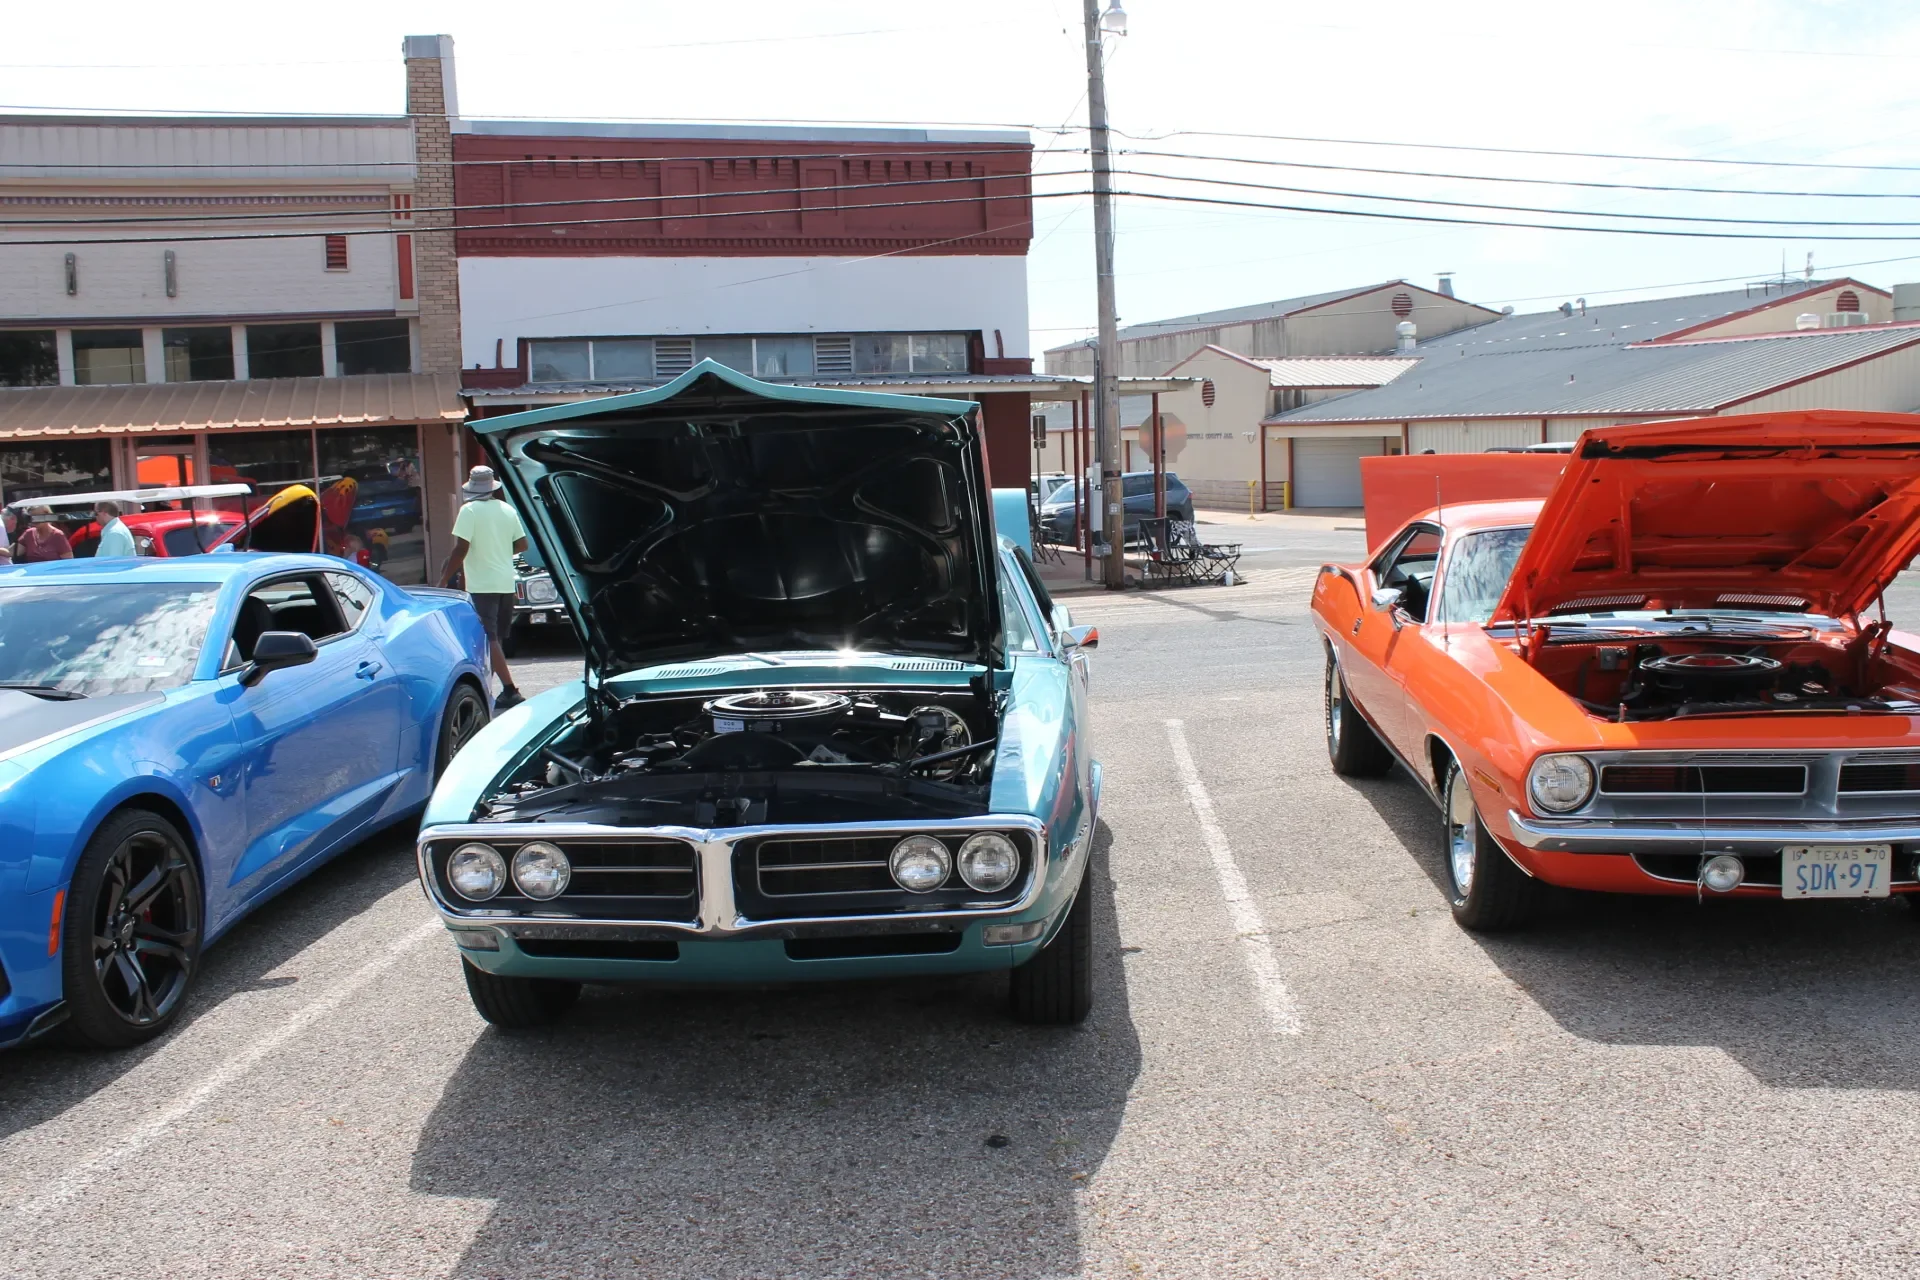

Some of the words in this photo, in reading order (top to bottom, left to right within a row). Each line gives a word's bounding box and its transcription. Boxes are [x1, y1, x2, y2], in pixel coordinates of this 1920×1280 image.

[1443, 768, 1453, 825] COOPER
[1816, 850, 1859, 860] TEXAS
[1873, 849, 1886, 860] 70
